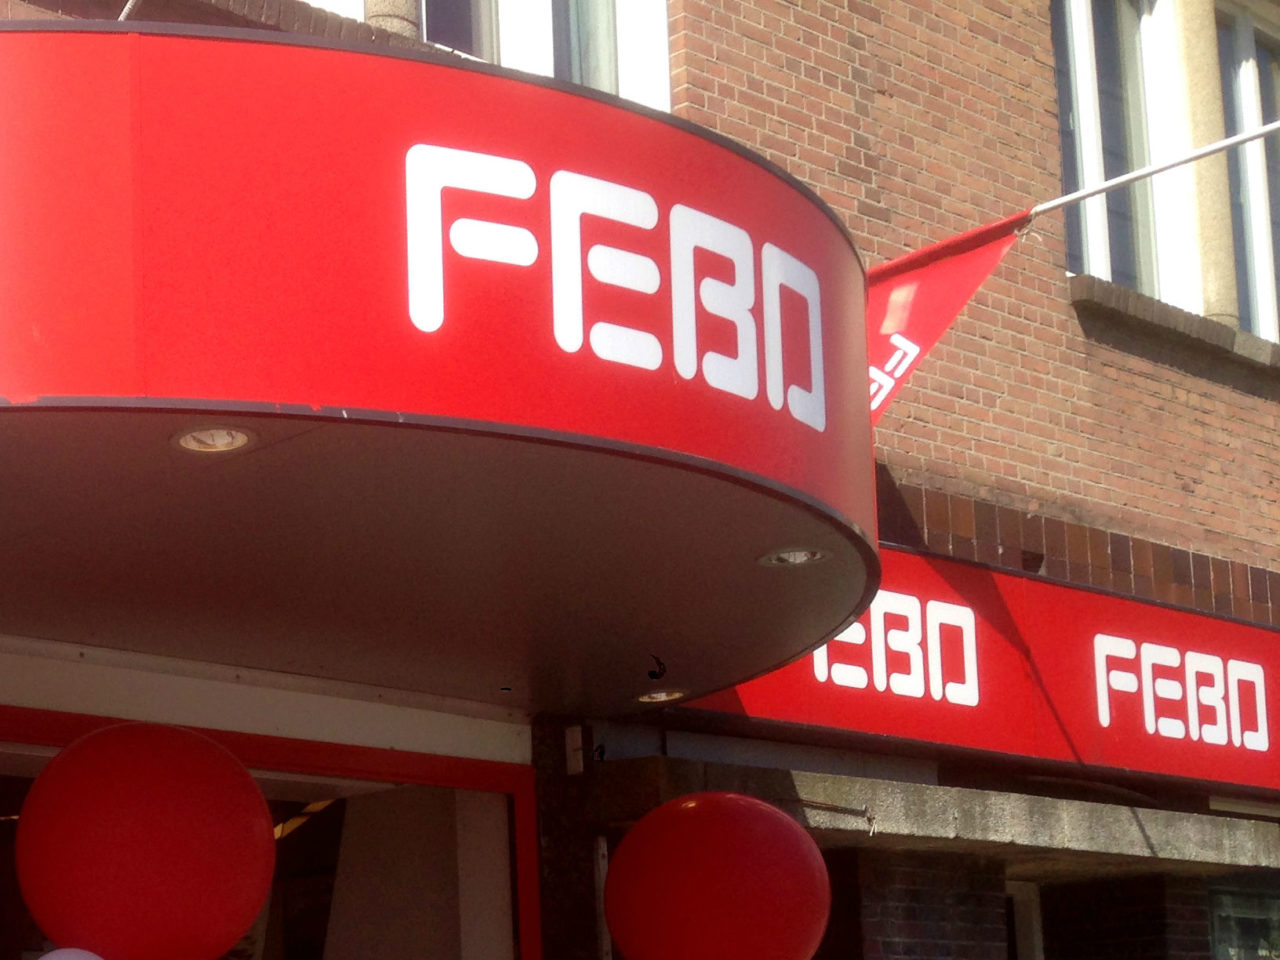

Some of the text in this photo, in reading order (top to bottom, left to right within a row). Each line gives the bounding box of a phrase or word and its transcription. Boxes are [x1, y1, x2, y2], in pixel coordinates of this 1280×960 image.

[405, 143, 826, 433] FEBO
[813, 589, 980, 707] EBO
[1093, 632, 1270, 752] FEBO
